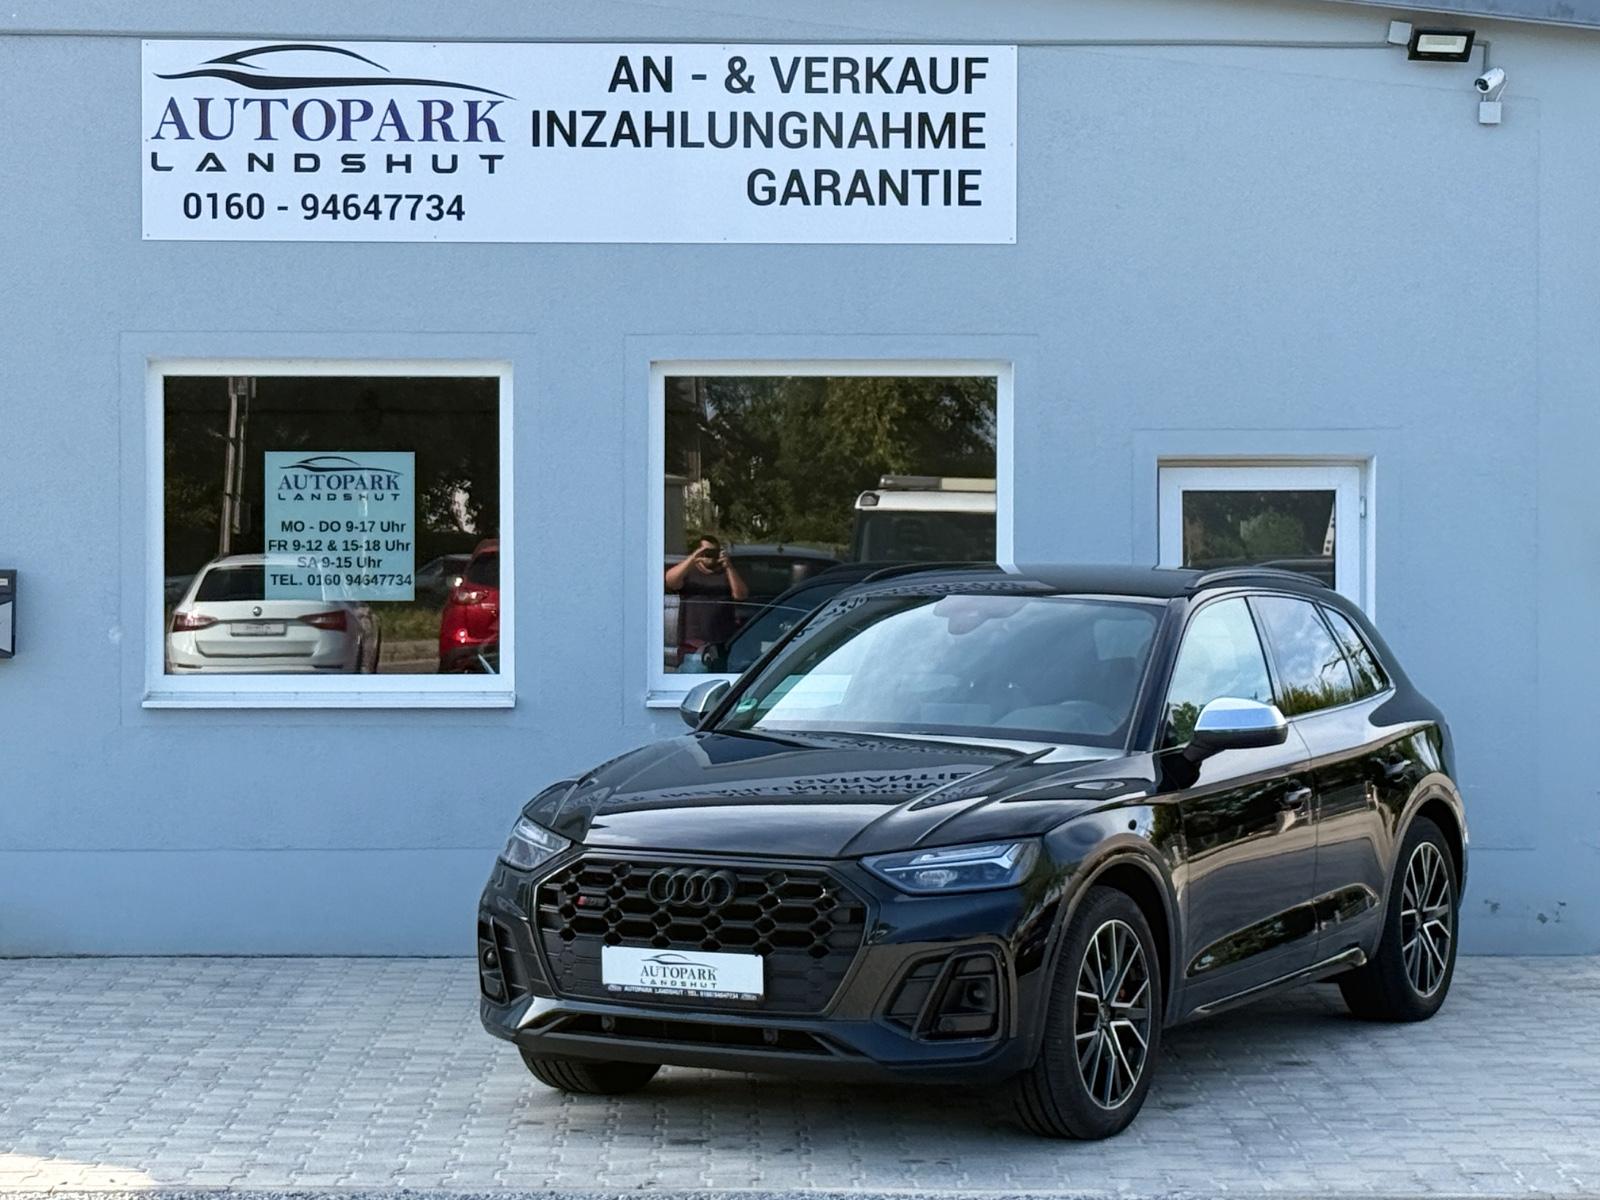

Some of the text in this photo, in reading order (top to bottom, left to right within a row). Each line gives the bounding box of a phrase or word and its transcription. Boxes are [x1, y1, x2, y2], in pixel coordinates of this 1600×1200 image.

[607, 55, 989, 95] AN - & VERKAUF
[151, 96, 506, 143] AUTOPARK
[532, 109, 986, 150] INZAHLUNGNAHME
[151, 151, 505, 174] LANDSHUT
[747, 168, 982, 207] GARANTIE
[183, 192, 265, 220] 0160
[300, 193, 466, 222] 94647734
[278, 474, 400, 490] AUTOPARK
[278, 493, 400, 501] LANDSHUT
[281, 520, 305, 533] MO
[319, 520, 342, 533] DO
[345, 520, 376, 533] 9-17
[380, 520, 407, 533] Uhr
[268, 539, 411, 552] FR 9-12 & 15-18 Uhr
[297, 556, 383, 569] SA 9-15 Uhr
[270, 573, 412, 586] TEL. 0160 94647734
[640, 965, 717, 981] AUTOPARK
[640, 979, 717, 989] LANDSHUT
